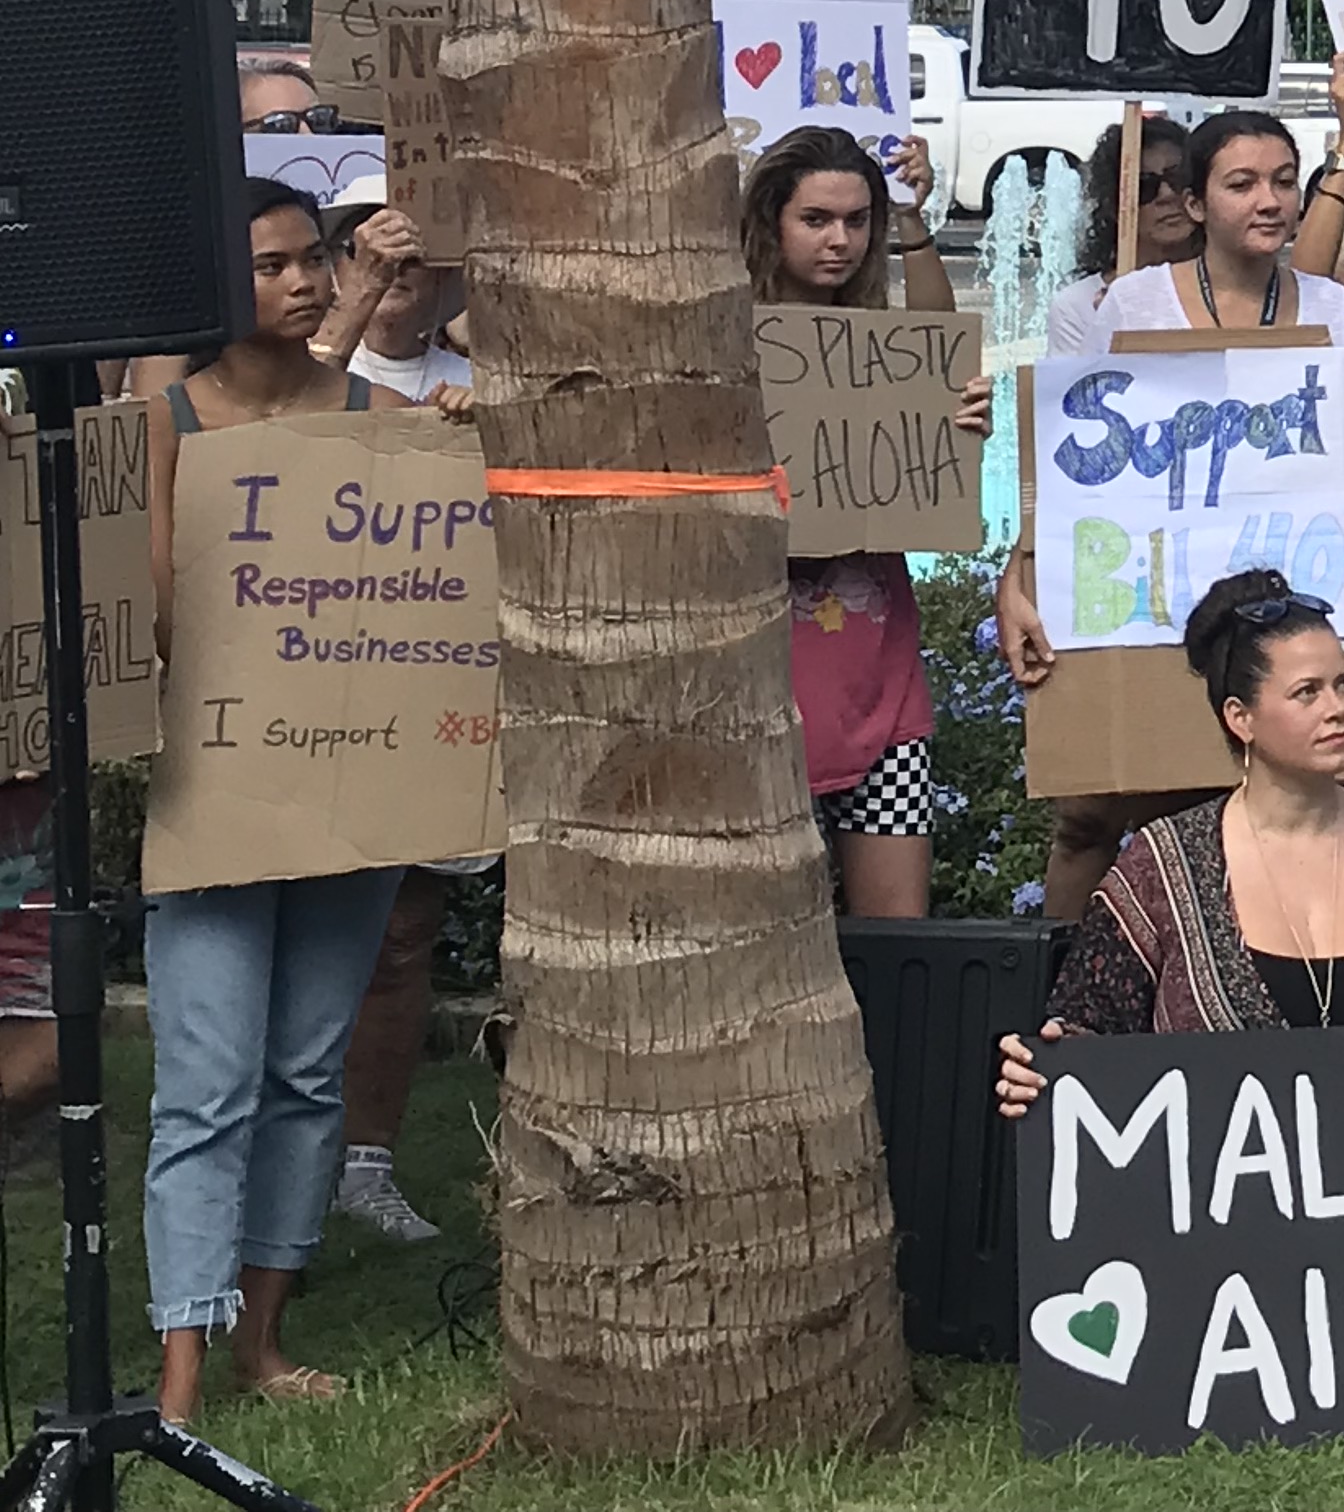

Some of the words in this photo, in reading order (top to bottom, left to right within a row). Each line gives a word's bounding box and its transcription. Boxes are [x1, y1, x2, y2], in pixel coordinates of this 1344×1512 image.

[811, 315, 968, 392] PLASTIC
[812, 410, 965, 511] ALOHA
[1053, 364, 1328, 511] Support
[228, 475, 279, 541] I
[326, 482, 495, 552] Suppo
[230, 563, 468, 619] Responsible
[1072, 516, 1195, 637] Bill
[276, 626, 499, 668] Businesses
[201, 698, 244, 748] I
